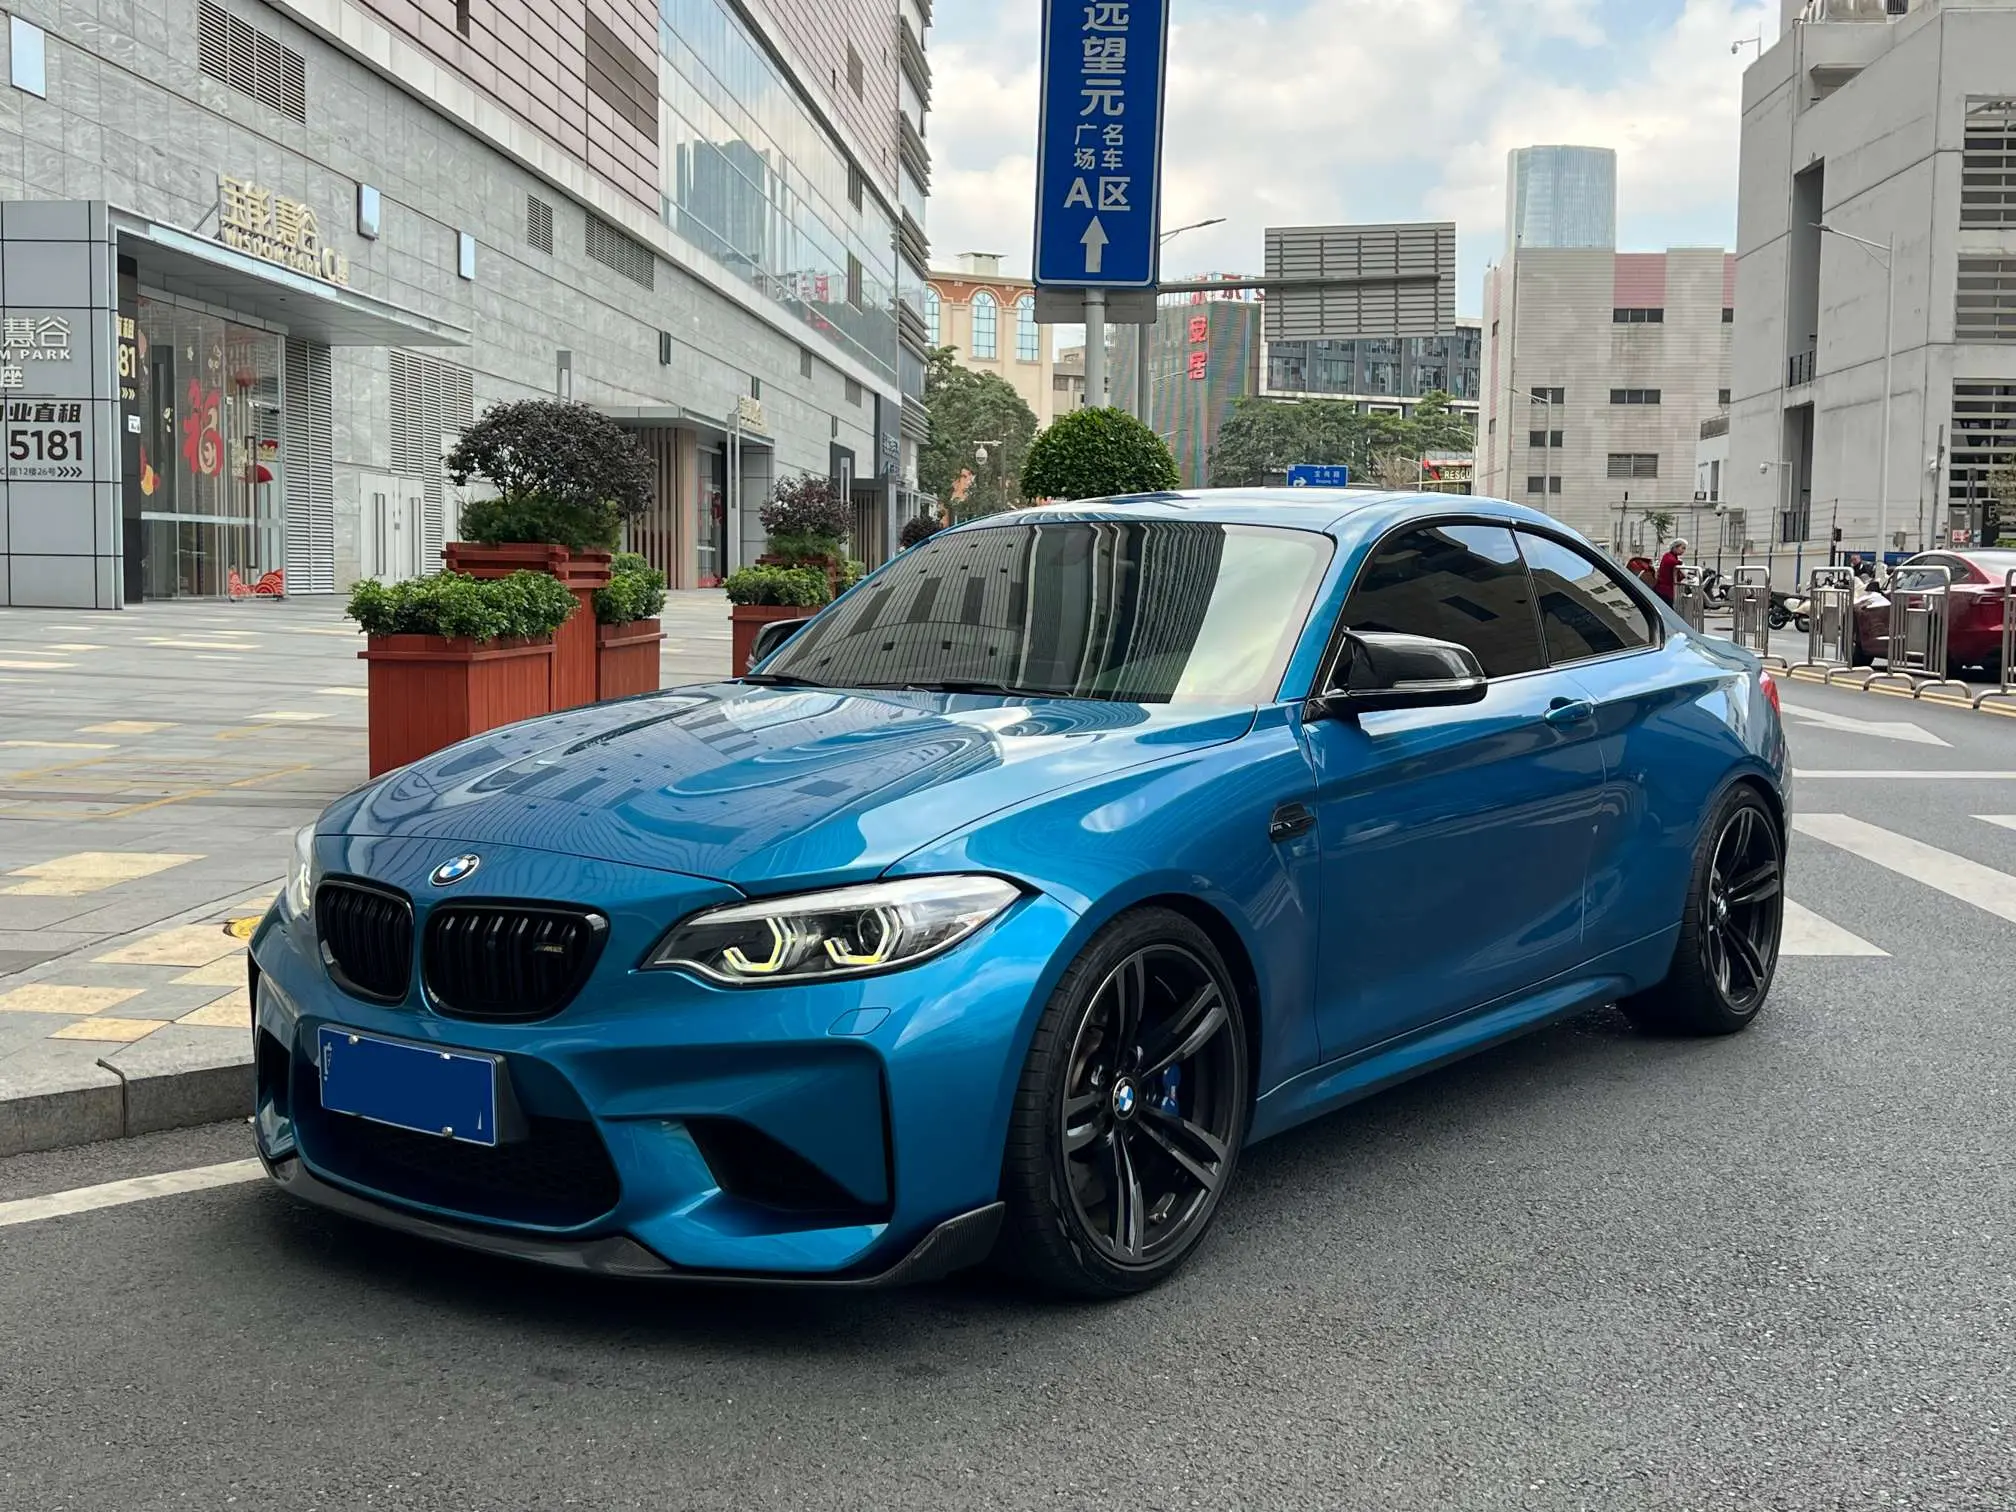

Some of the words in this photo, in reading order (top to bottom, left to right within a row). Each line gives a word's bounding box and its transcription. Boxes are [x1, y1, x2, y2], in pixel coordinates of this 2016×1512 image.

[1080, 0, 1129, 116] 远望元
[1074, 124, 1098, 170] 广场
[1101, 124, 1123, 170] 名车
[1063, 176, 1131, 211] A区
[221, 225, 287, 265] WISDOM
[288, 249, 322, 279] PARK
[3, 316, 71, 348] 慧谷
[20, 349, 71, 360] PARK
[119, 343, 136, 378] 81
[0, 403, 81, 423] 业直租
[9, 430, 82, 461] 5181
